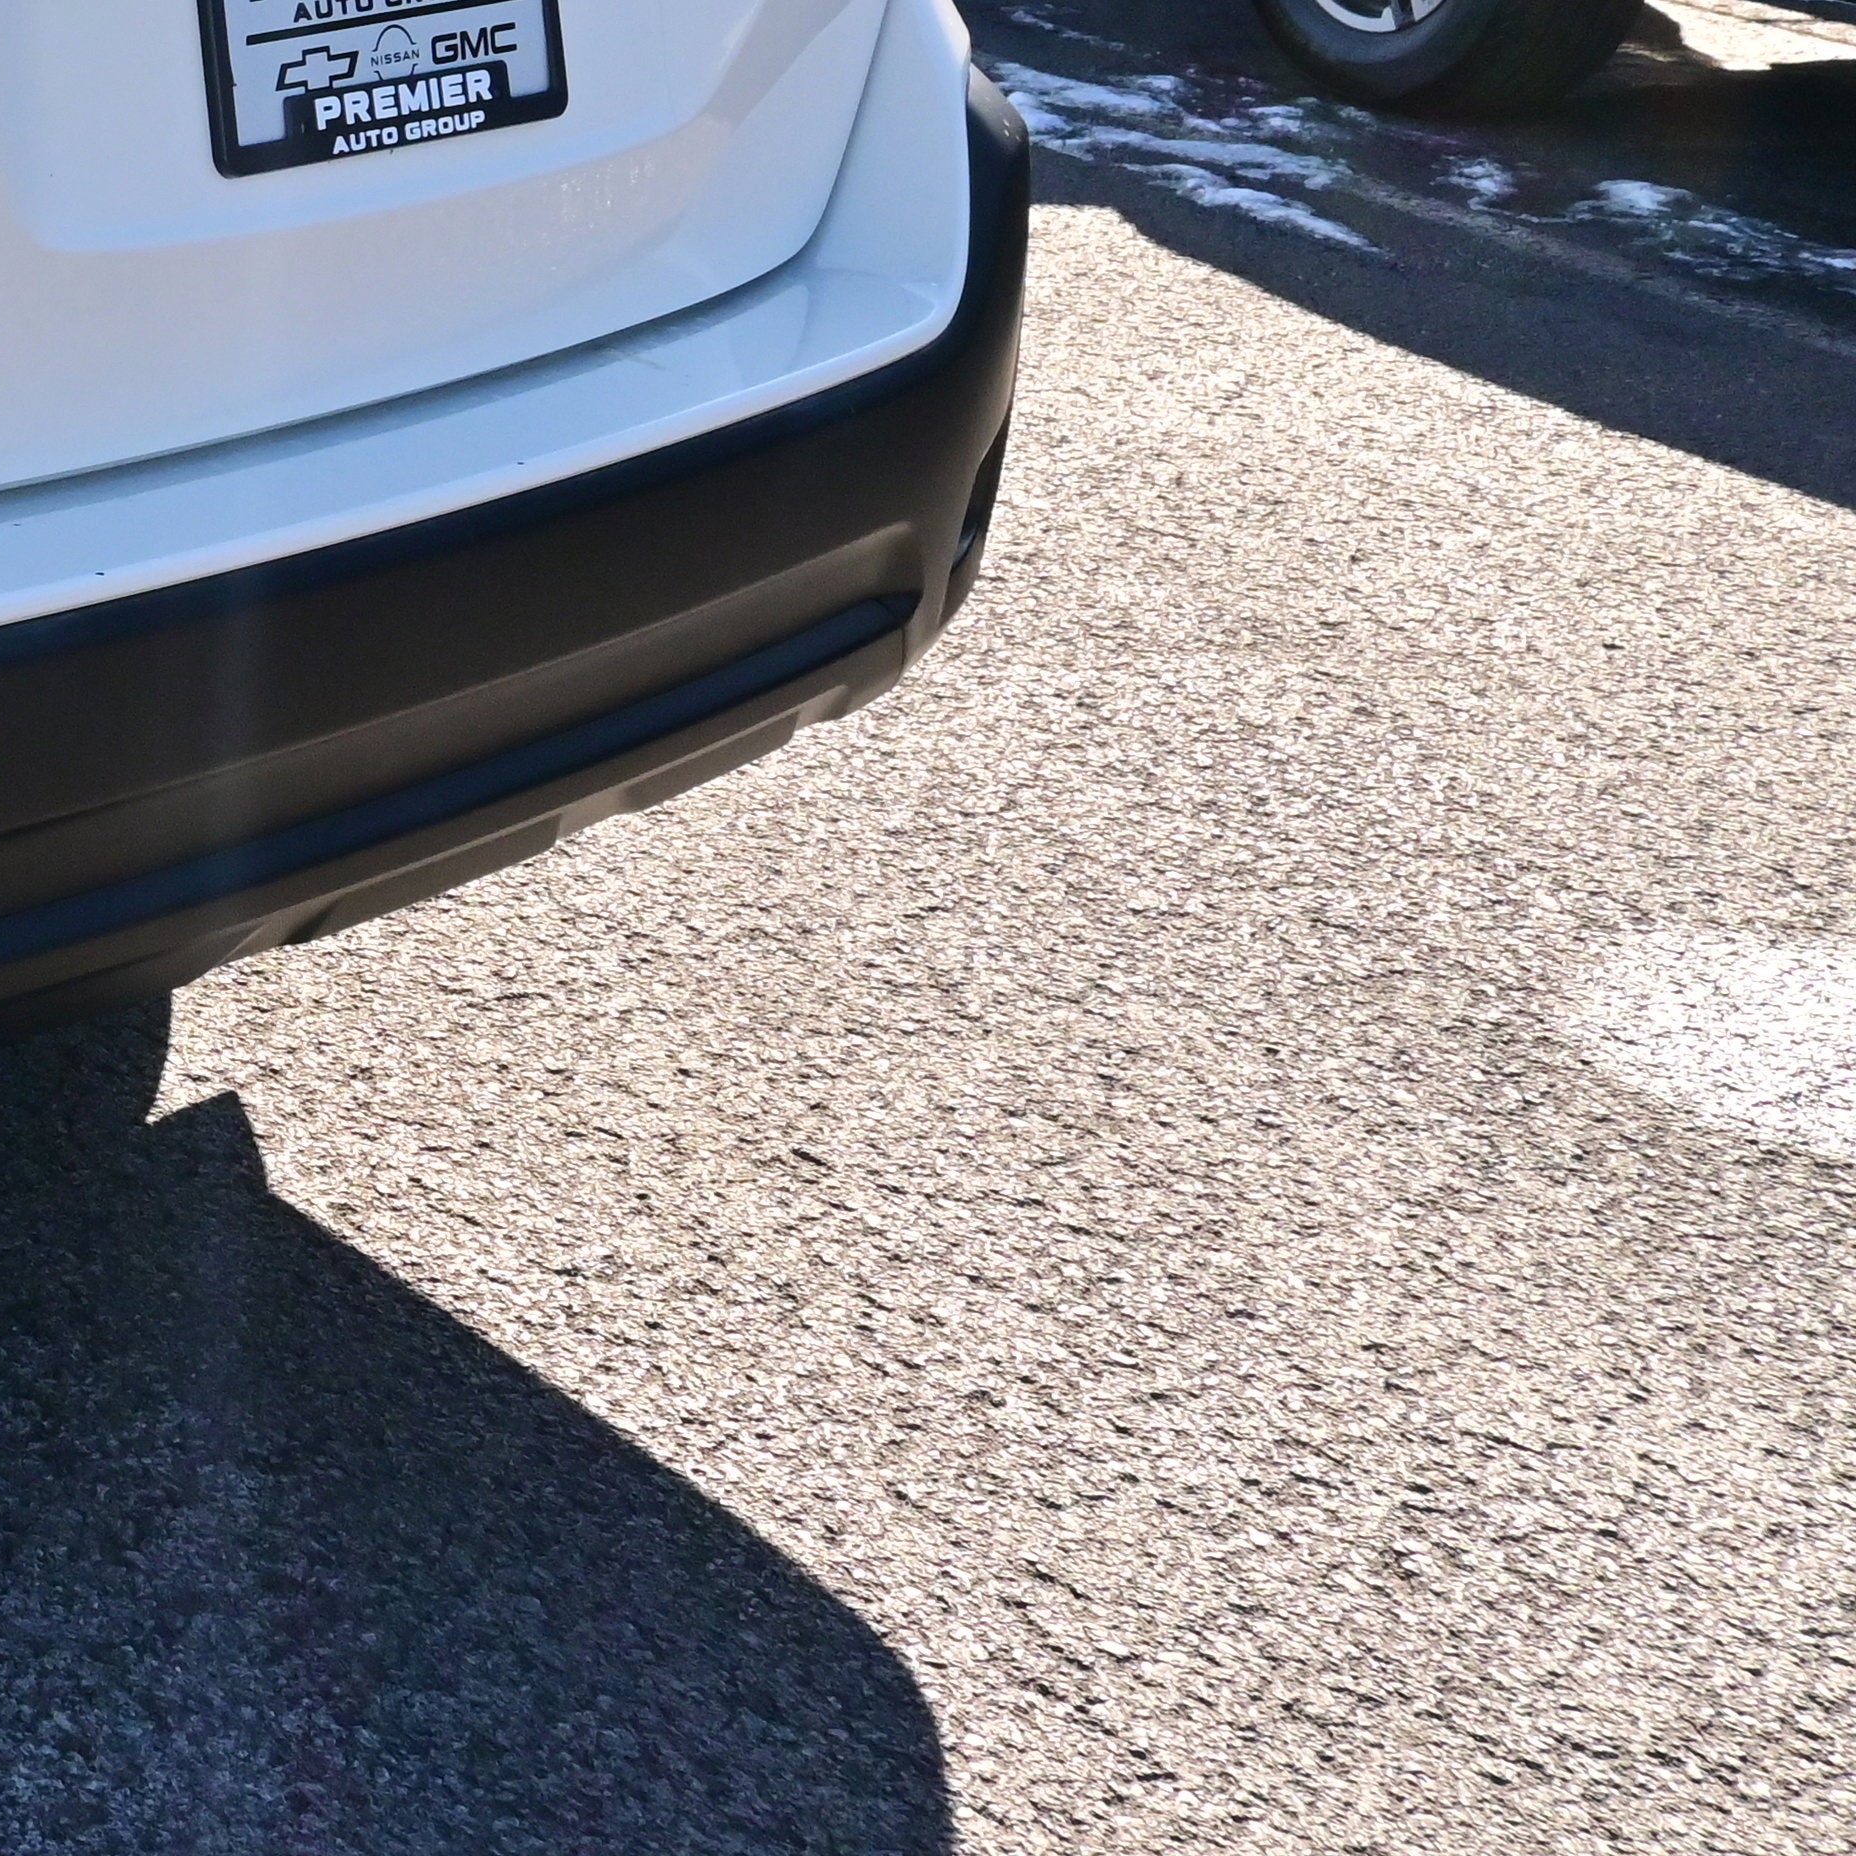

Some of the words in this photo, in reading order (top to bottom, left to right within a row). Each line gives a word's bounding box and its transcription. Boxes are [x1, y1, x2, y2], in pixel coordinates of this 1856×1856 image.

[370, 48, 420, 68] NISSAN
[431, 22, 517, 65] GMC
[314, 69, 493, 131] PREMIER
[333, 125, 398, 155] AUTO
[405, 110, 486, 141] GROUP
